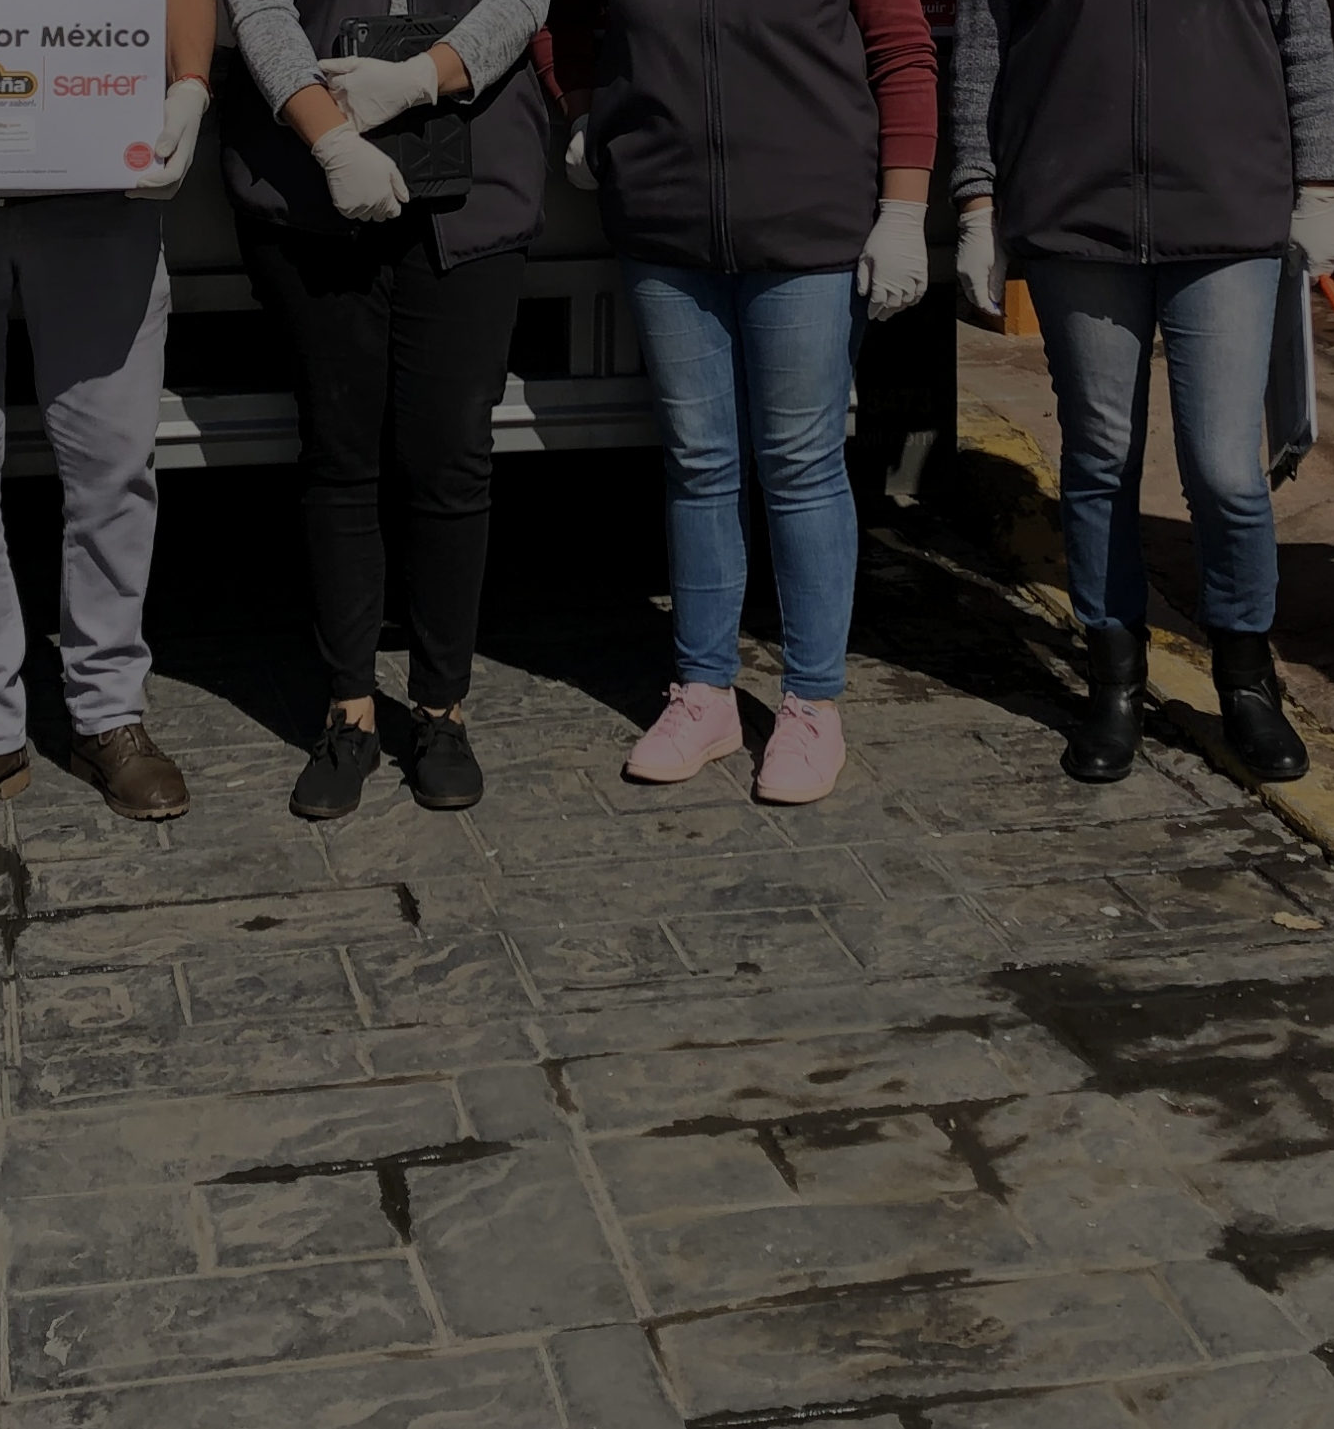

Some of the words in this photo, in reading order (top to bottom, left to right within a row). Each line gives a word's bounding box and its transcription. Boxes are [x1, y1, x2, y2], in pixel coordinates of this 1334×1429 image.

[923, 3, 946, 14] uir
[41, 22, 150, 48] México
[53, 74, 141, 97] sanfer
[859, 387, 933, 415] -5473
